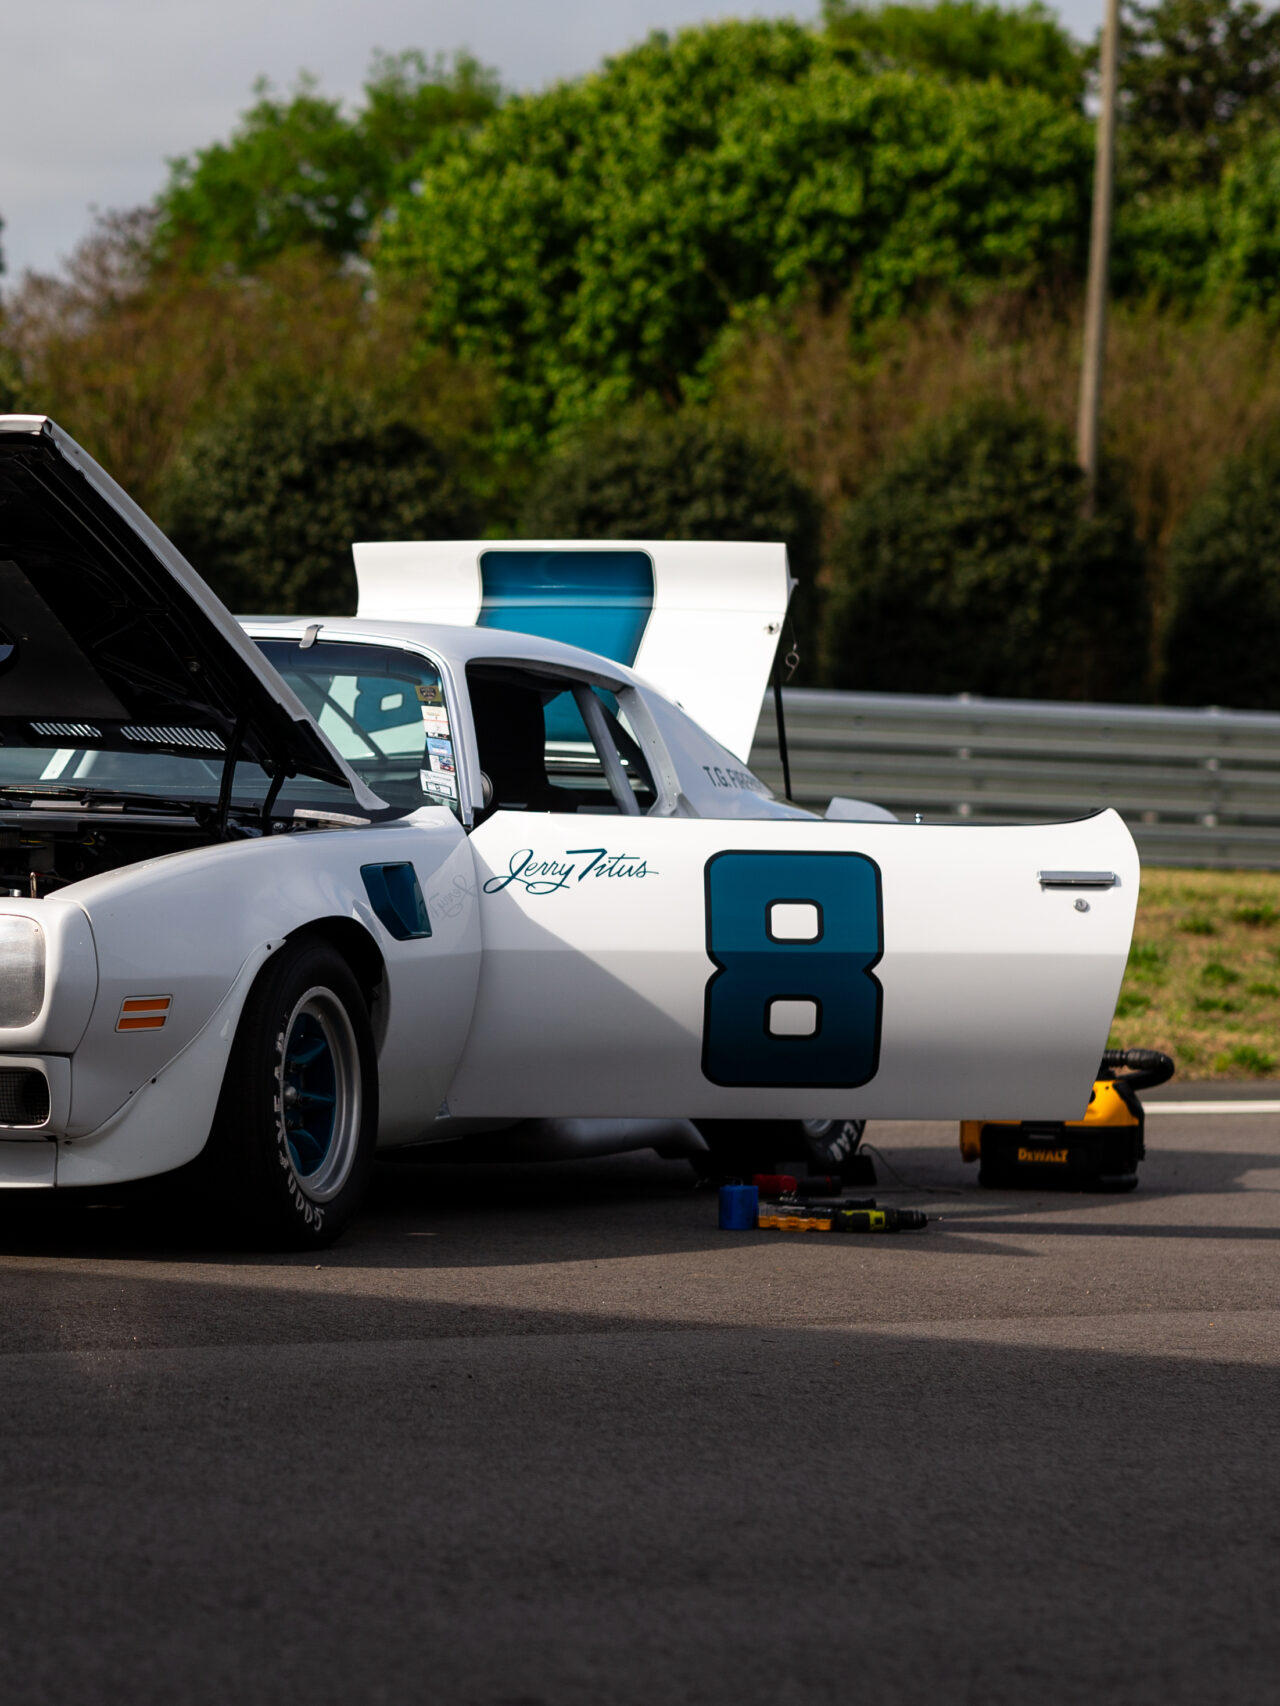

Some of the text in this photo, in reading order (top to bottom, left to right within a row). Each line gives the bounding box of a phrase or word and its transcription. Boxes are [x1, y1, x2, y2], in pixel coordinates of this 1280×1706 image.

[483, 848, 660, 895] Jerry Titus
[701, 849, 885, 1090] 8
